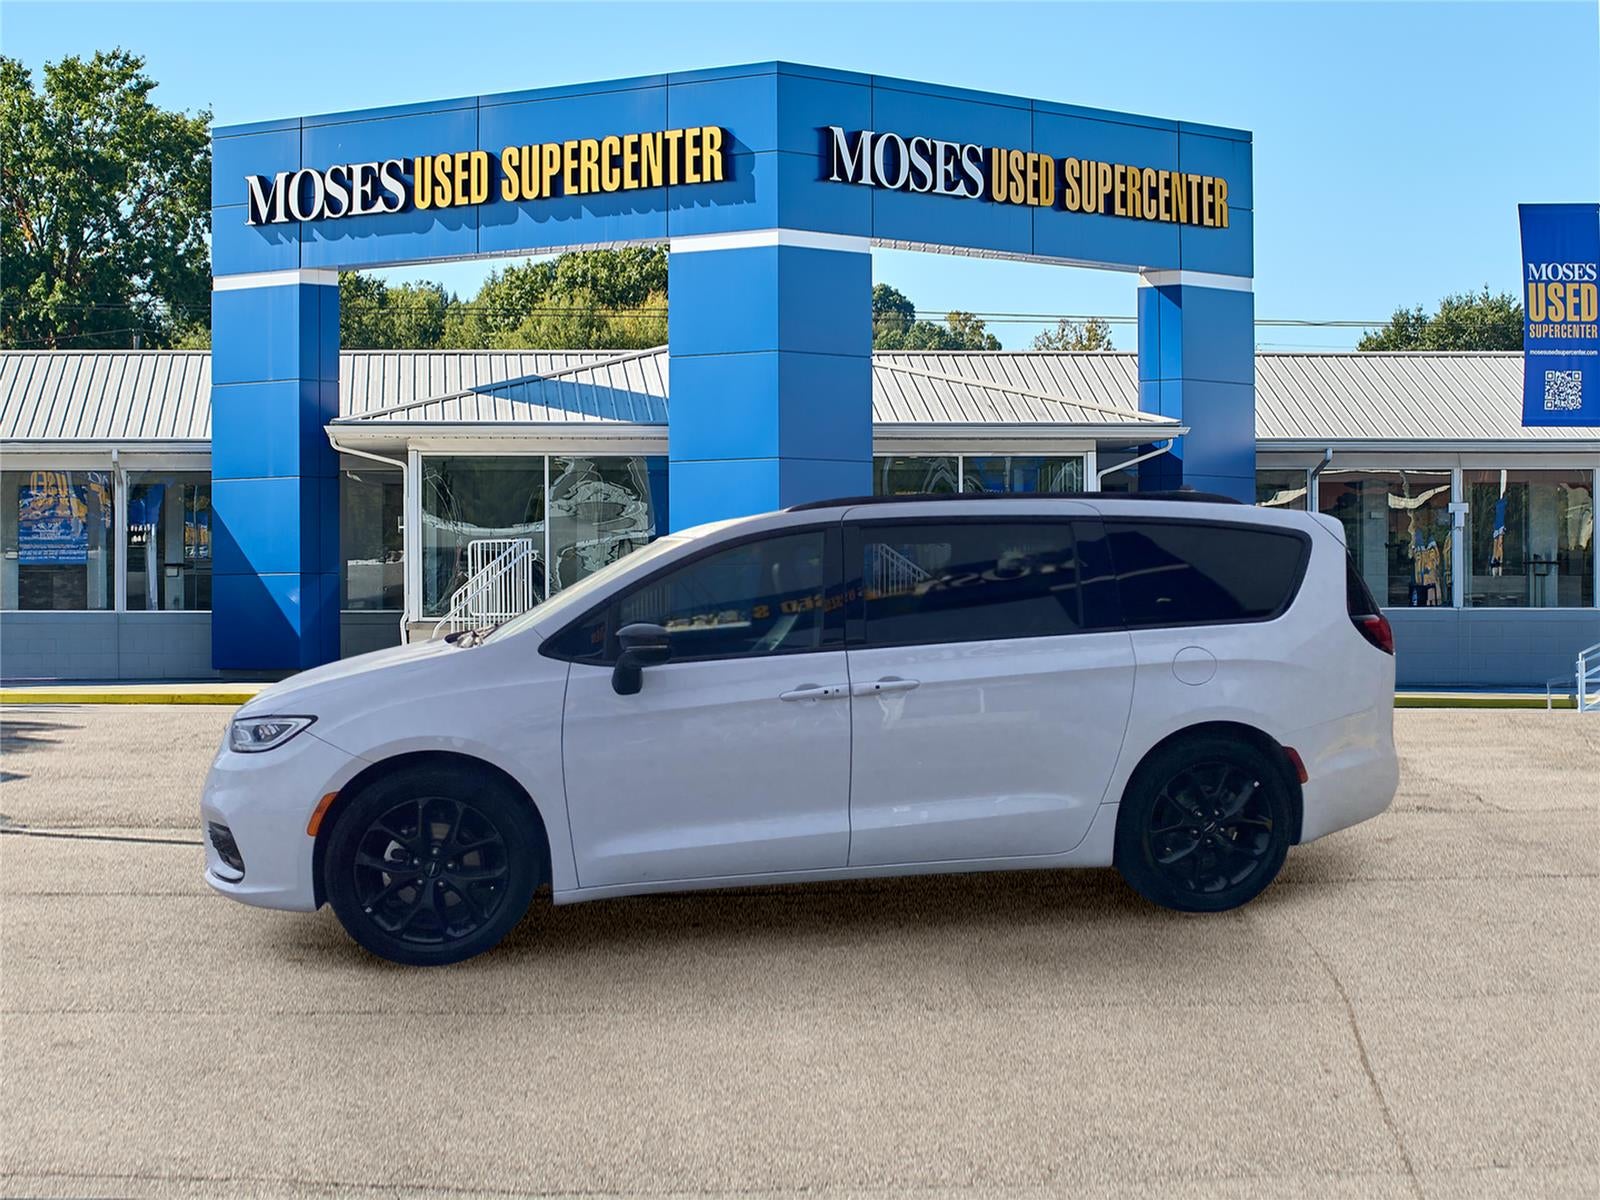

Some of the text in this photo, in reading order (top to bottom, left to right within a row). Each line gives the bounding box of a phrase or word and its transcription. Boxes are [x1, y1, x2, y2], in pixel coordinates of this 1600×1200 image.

[244, 125, 724, 226] MOSES USED SUPERCENTER
[829, 126, 1229, 228] MOSES USED SUPERCENTER
[1528, 263, 1598, 281] MOSES
[1528, 282, 1598, 322] USED
[1529, 324, 1598, 339] SUPERCENTER
